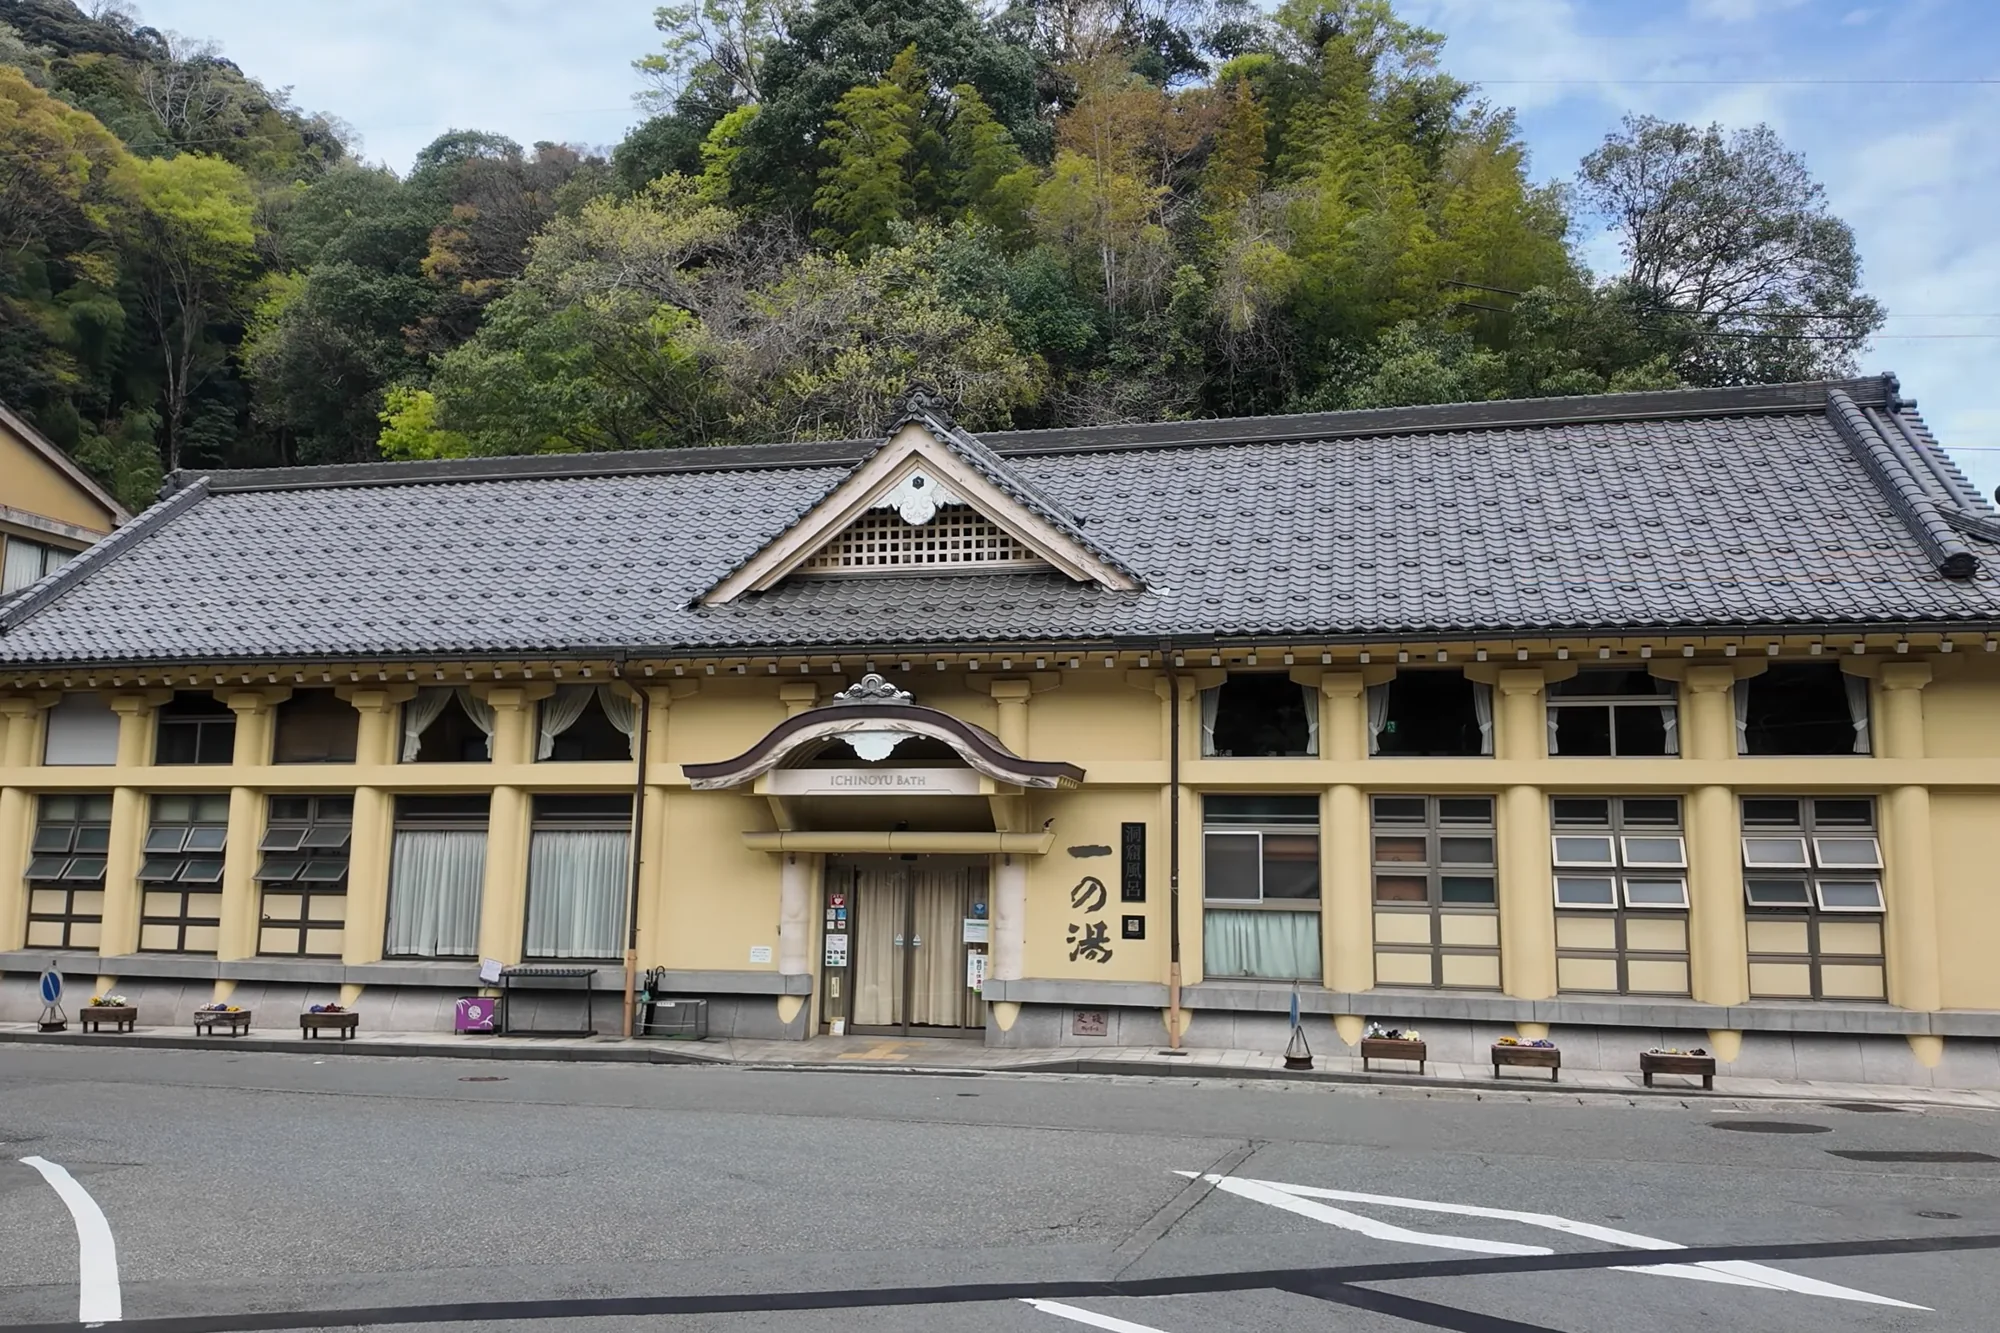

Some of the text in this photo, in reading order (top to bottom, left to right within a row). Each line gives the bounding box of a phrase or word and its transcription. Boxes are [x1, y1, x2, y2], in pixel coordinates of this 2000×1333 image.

[830, 775, 926, 786] ICHINOYU BATH
[1125, 826, 1142, 897] 洞窟風呂
[1066, 844, 1113, 964] 一の湯
